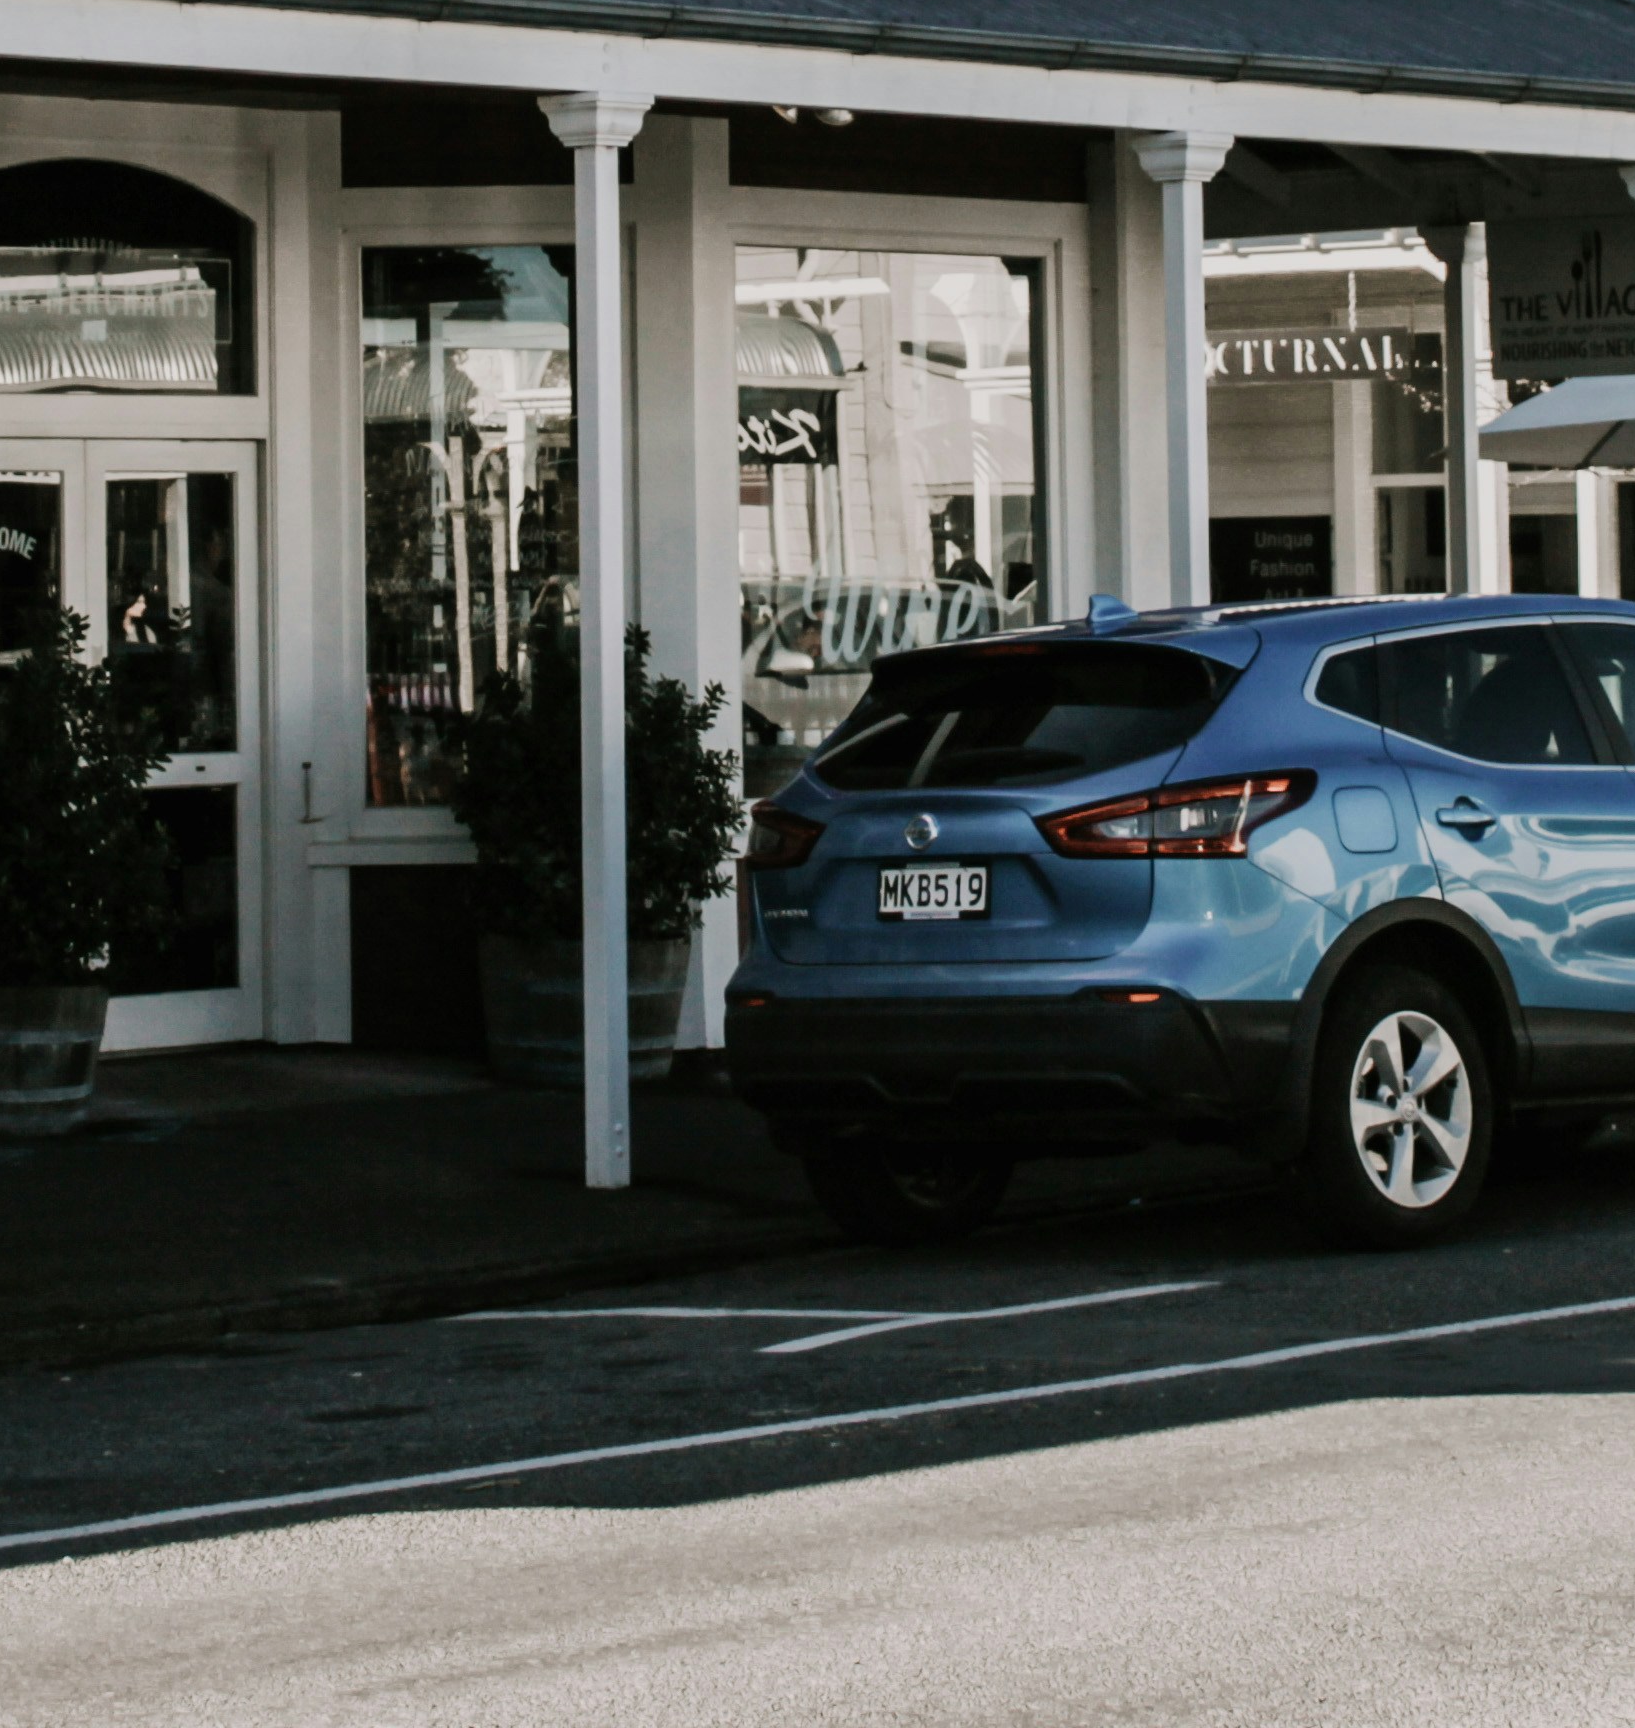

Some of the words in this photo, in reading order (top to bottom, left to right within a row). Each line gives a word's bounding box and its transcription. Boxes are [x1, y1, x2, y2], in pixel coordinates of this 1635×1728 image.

[1500, 294, 1549, 322] THE
[1204, 334, 1404, 376] CTURNAL
[1254, 531, 1314, 551] Unique
[882, 873, 983, 908] MKB519
